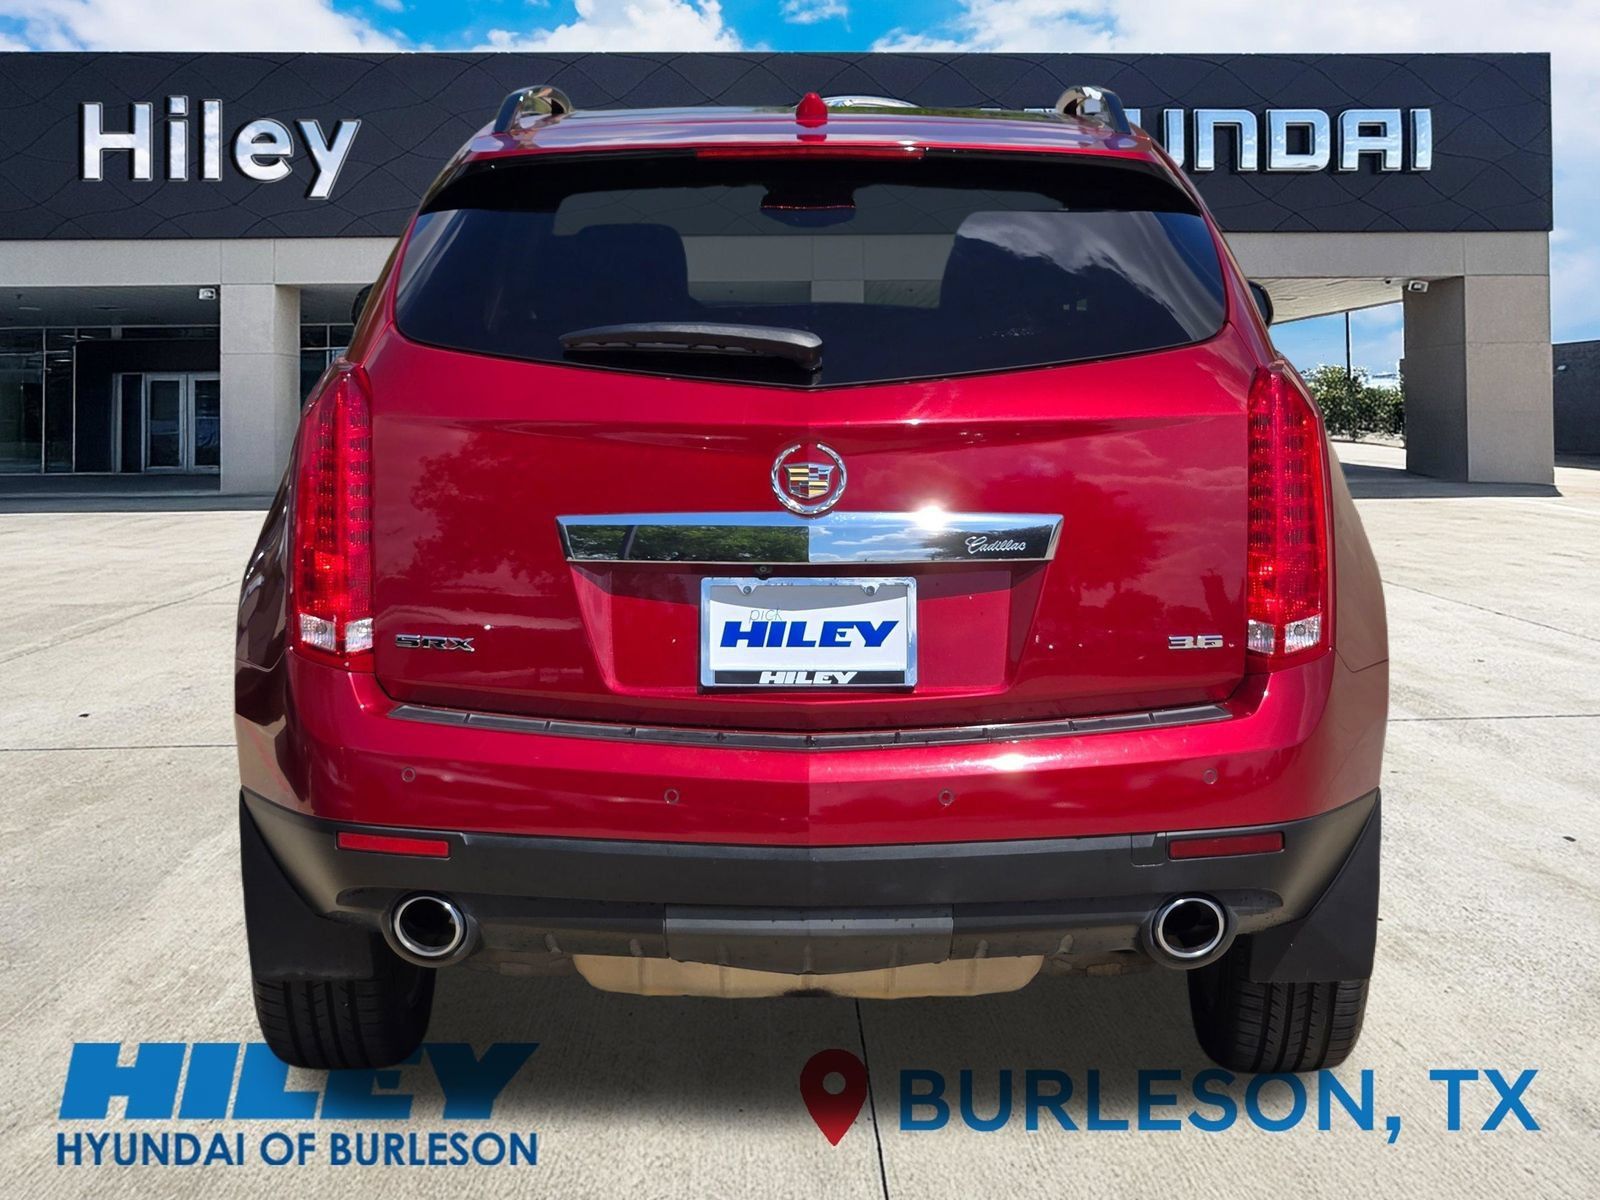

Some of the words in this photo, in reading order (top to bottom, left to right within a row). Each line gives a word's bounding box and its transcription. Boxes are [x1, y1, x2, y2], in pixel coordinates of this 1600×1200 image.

[80, 95, 361, 200] Hiley
[980, 108, 1432, 171] UNDAI
[965, 536, 1026, 554] Cadillac
[395, 634, 475, 652] SRX
[720, 620, 899, 647] HILEY
[759, 671, 857, 684] HILEY
